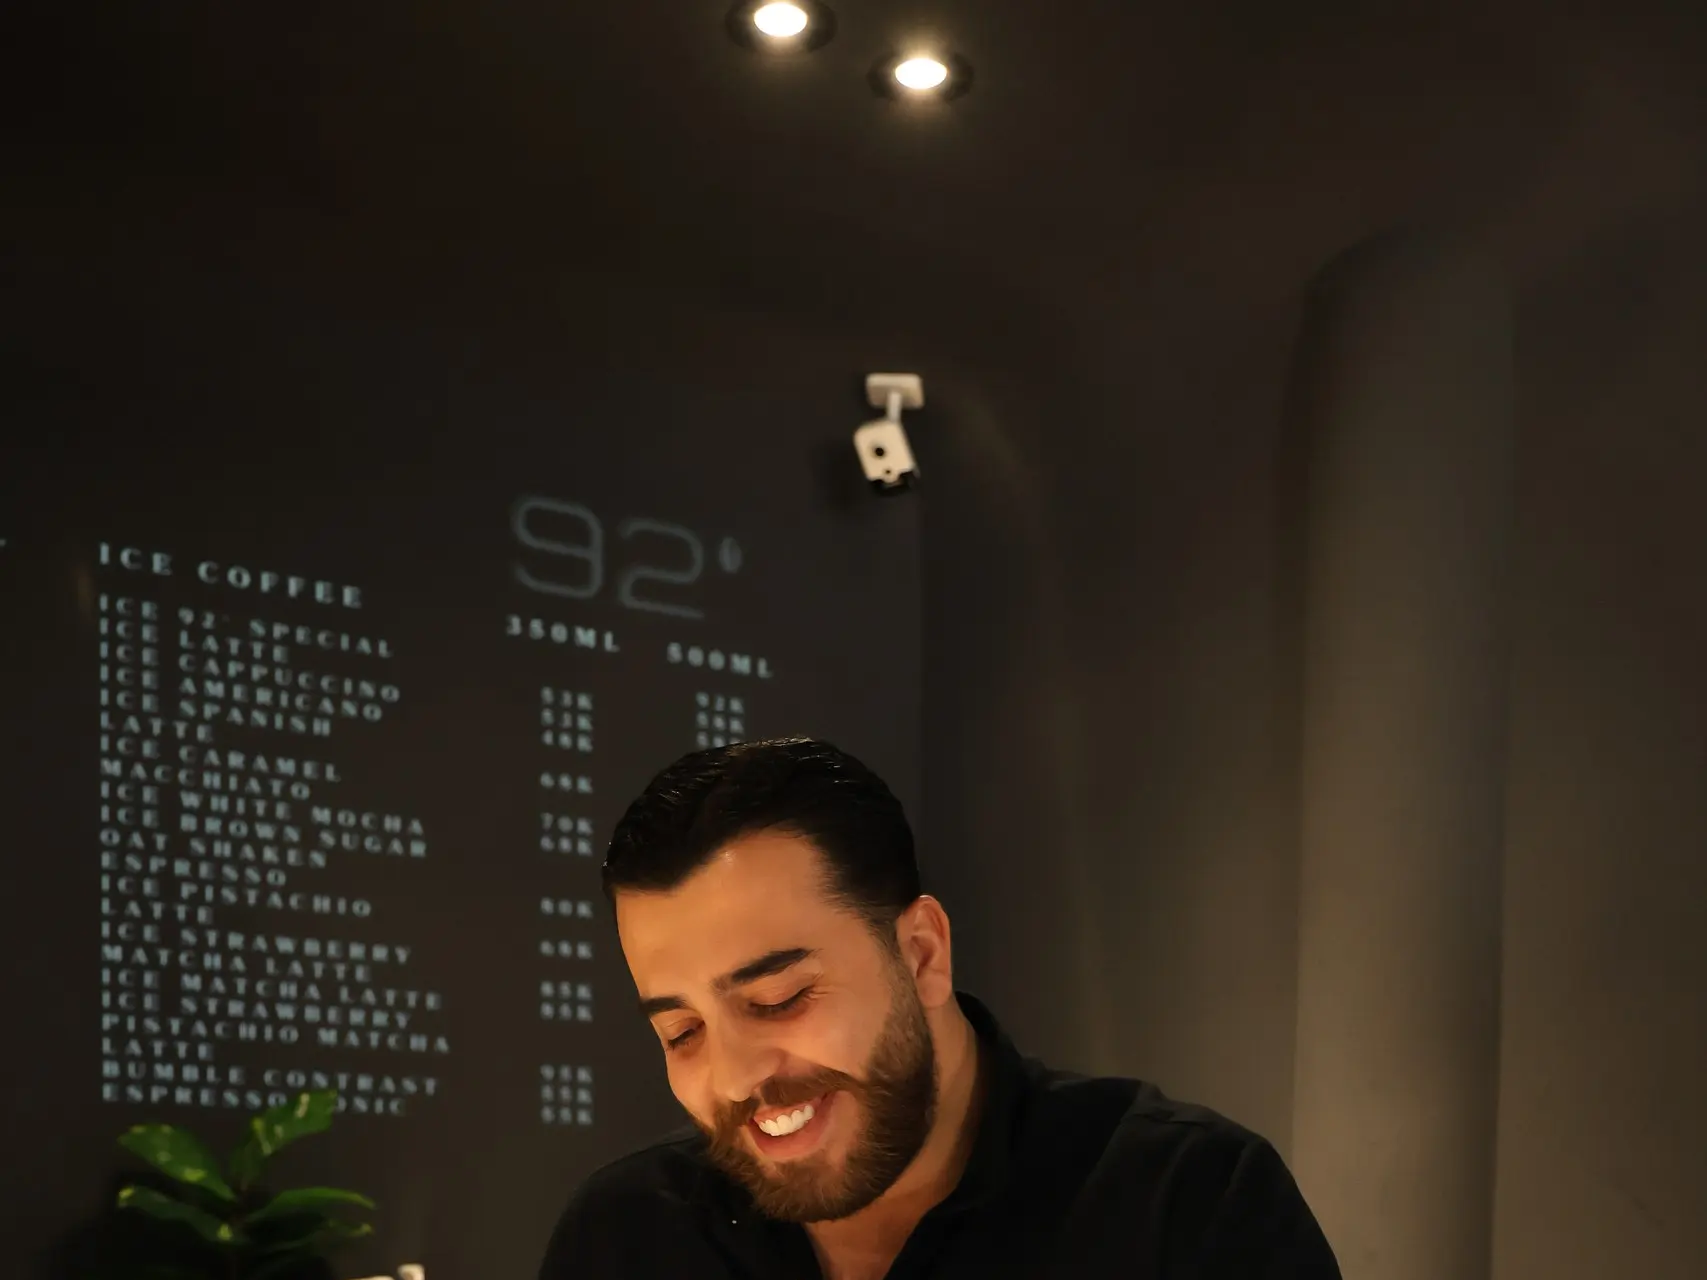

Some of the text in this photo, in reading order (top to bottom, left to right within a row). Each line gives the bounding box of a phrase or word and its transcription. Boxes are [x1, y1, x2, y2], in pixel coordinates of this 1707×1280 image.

[98, 542, 364, 609] ICE COFFEE
[98, 594, 159, 620] ICE
[248, 620, 392, 659] SPECIAL
[98, 617, 289, 664] ICE LATTE
[506, 614, 773, 679] 350ML 500ML
[98, 641, 400, 703] ICE CAPPUCCINO
[98, 664, 382, 722] ICE AMERICANO
[99, 688, 331, 737] ICE SPANISH
[99, 711, 213, 743] LATTE
[99, 734, 339, 782] ICE CARAMEL
[99, 758, 310, 801] MACCHIATO
[99, 781, 423, 836] ICE WHITE MOCHA
[98, 829, 326, 868] OAT SHAKEN
[99, 804, 426, 858] ICE BROWN SUGAR
[100, 851, 287, 887] ESPRESSO
[100, 874, 372, 917] ICE PISTACHIO
[100, 897, 213, 925] LATTE
[100, 921, 410, 965] ICE STRAWBERRY
[100, 943, 371, 983] MATCHA LATTE
[100, 968, 441, 1011] ICE MATCHA LATTE
[100, 990, 410, 1030] ICE STRAWBERRY
[100, 1013, 449, 1053] PISTACHIO MATCHA
[101, 1037, 213, 1061] LATTE
[101, 1059, 438, 1096] BUMBLE CONTRAST
[101, 1083, 404, 1115] ESPRESSO ONIC
